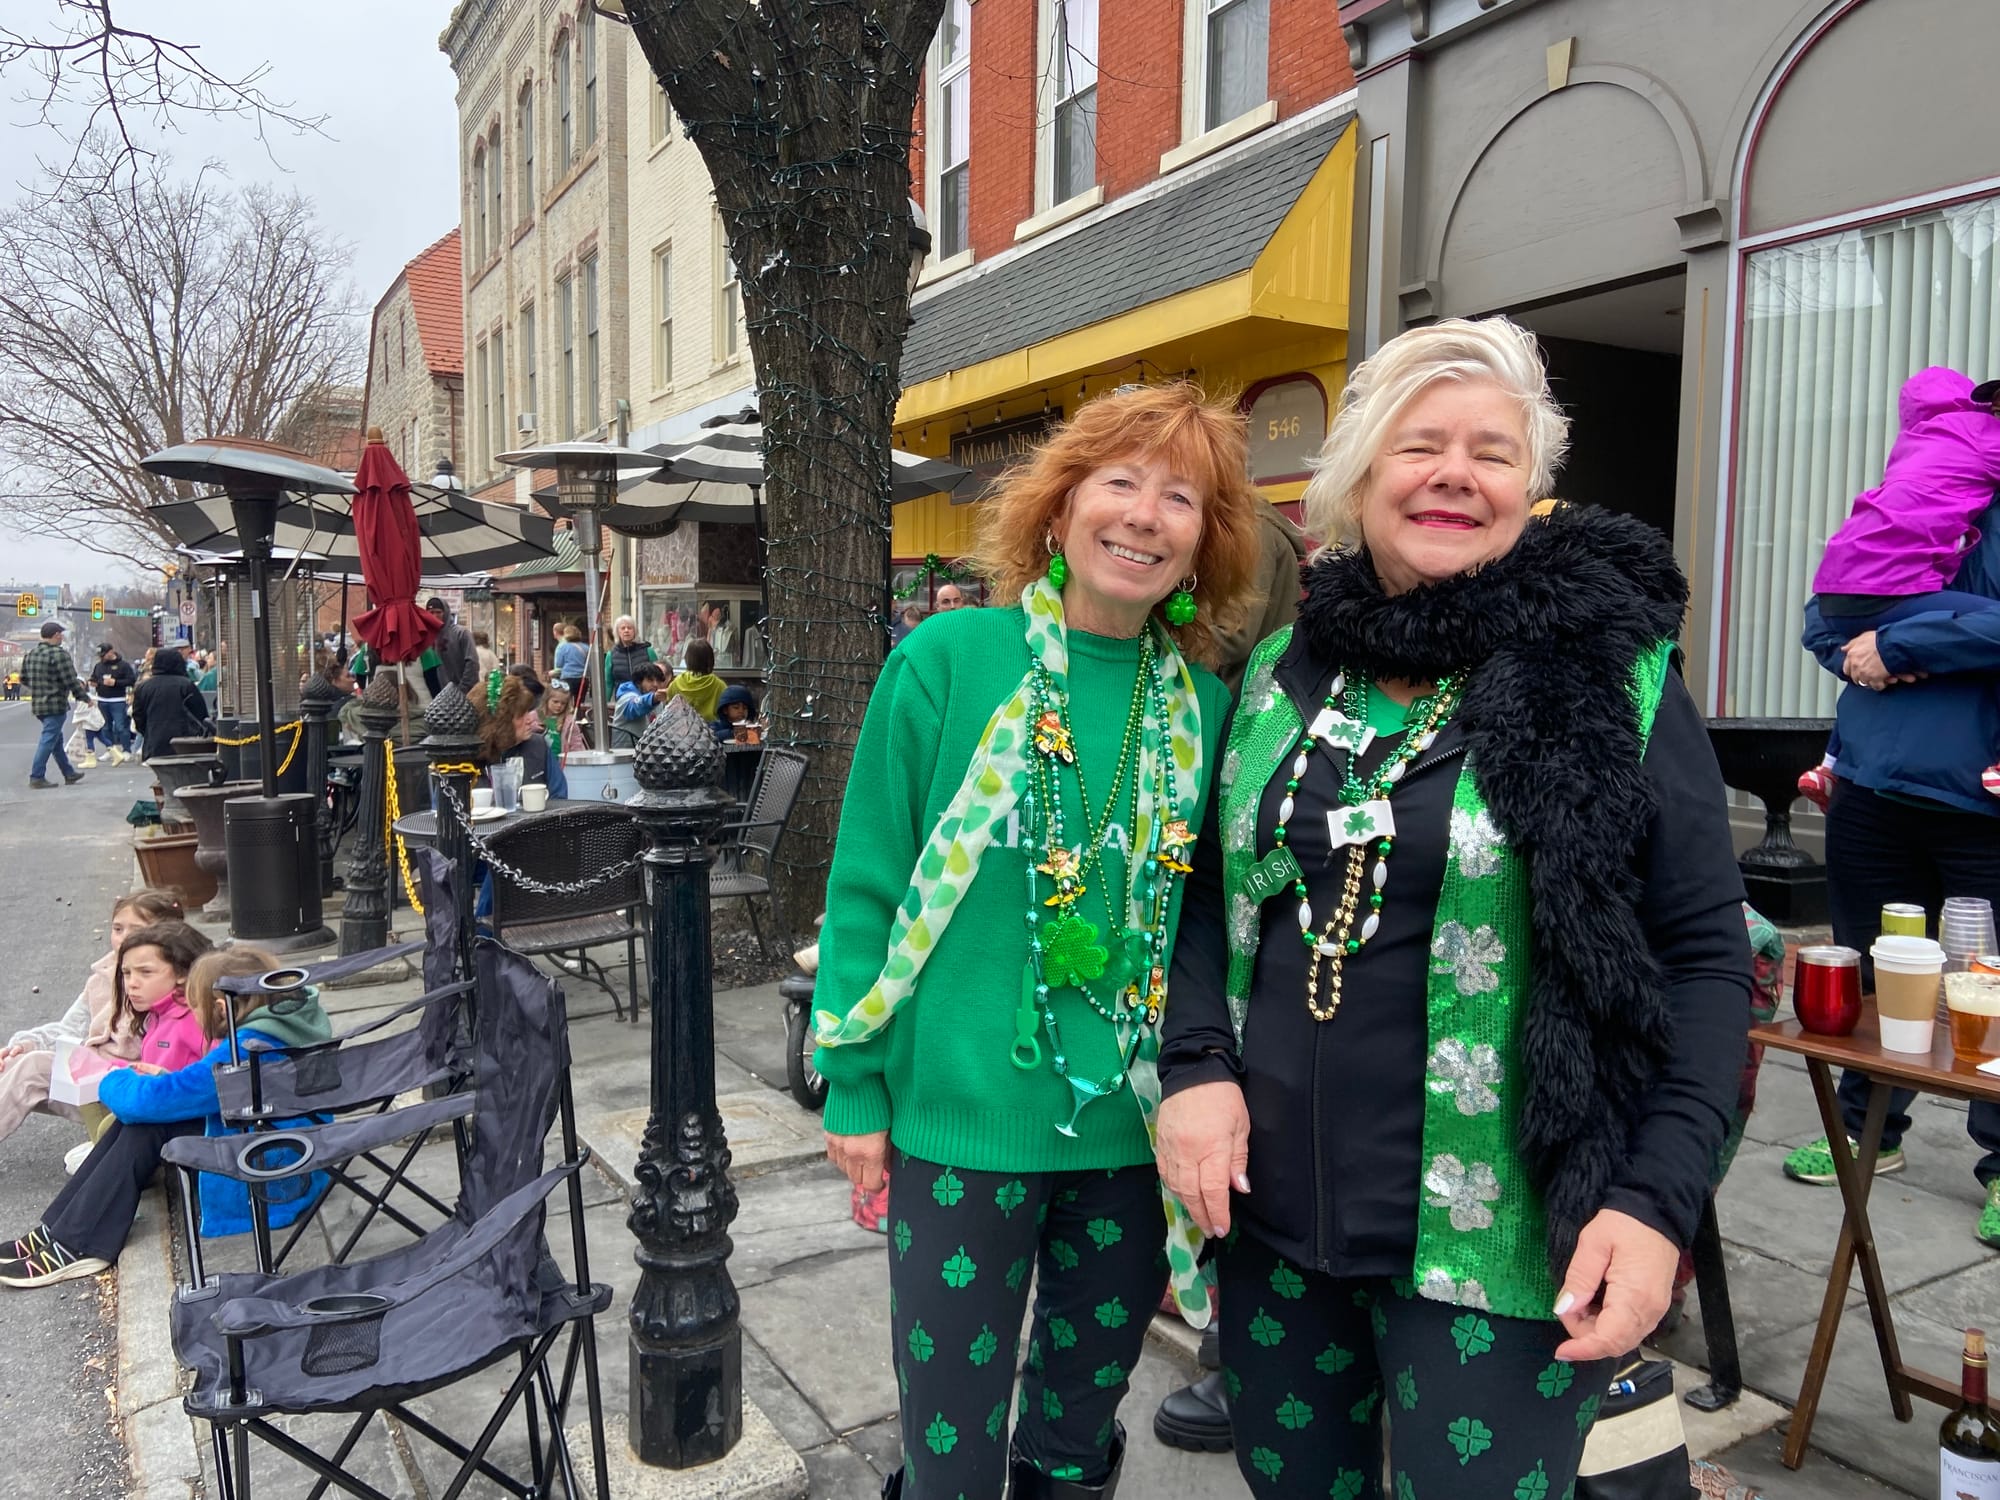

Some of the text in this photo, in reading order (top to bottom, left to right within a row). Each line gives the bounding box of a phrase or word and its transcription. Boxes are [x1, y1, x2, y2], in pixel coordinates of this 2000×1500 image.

[1269, 416, 1300, 440] 546
[961, 441, 1005, 467] MAMA
[1246, 855, 1295, 894] IRISH
[1943, 1458, 1999, 1482] FRANCISCAN
